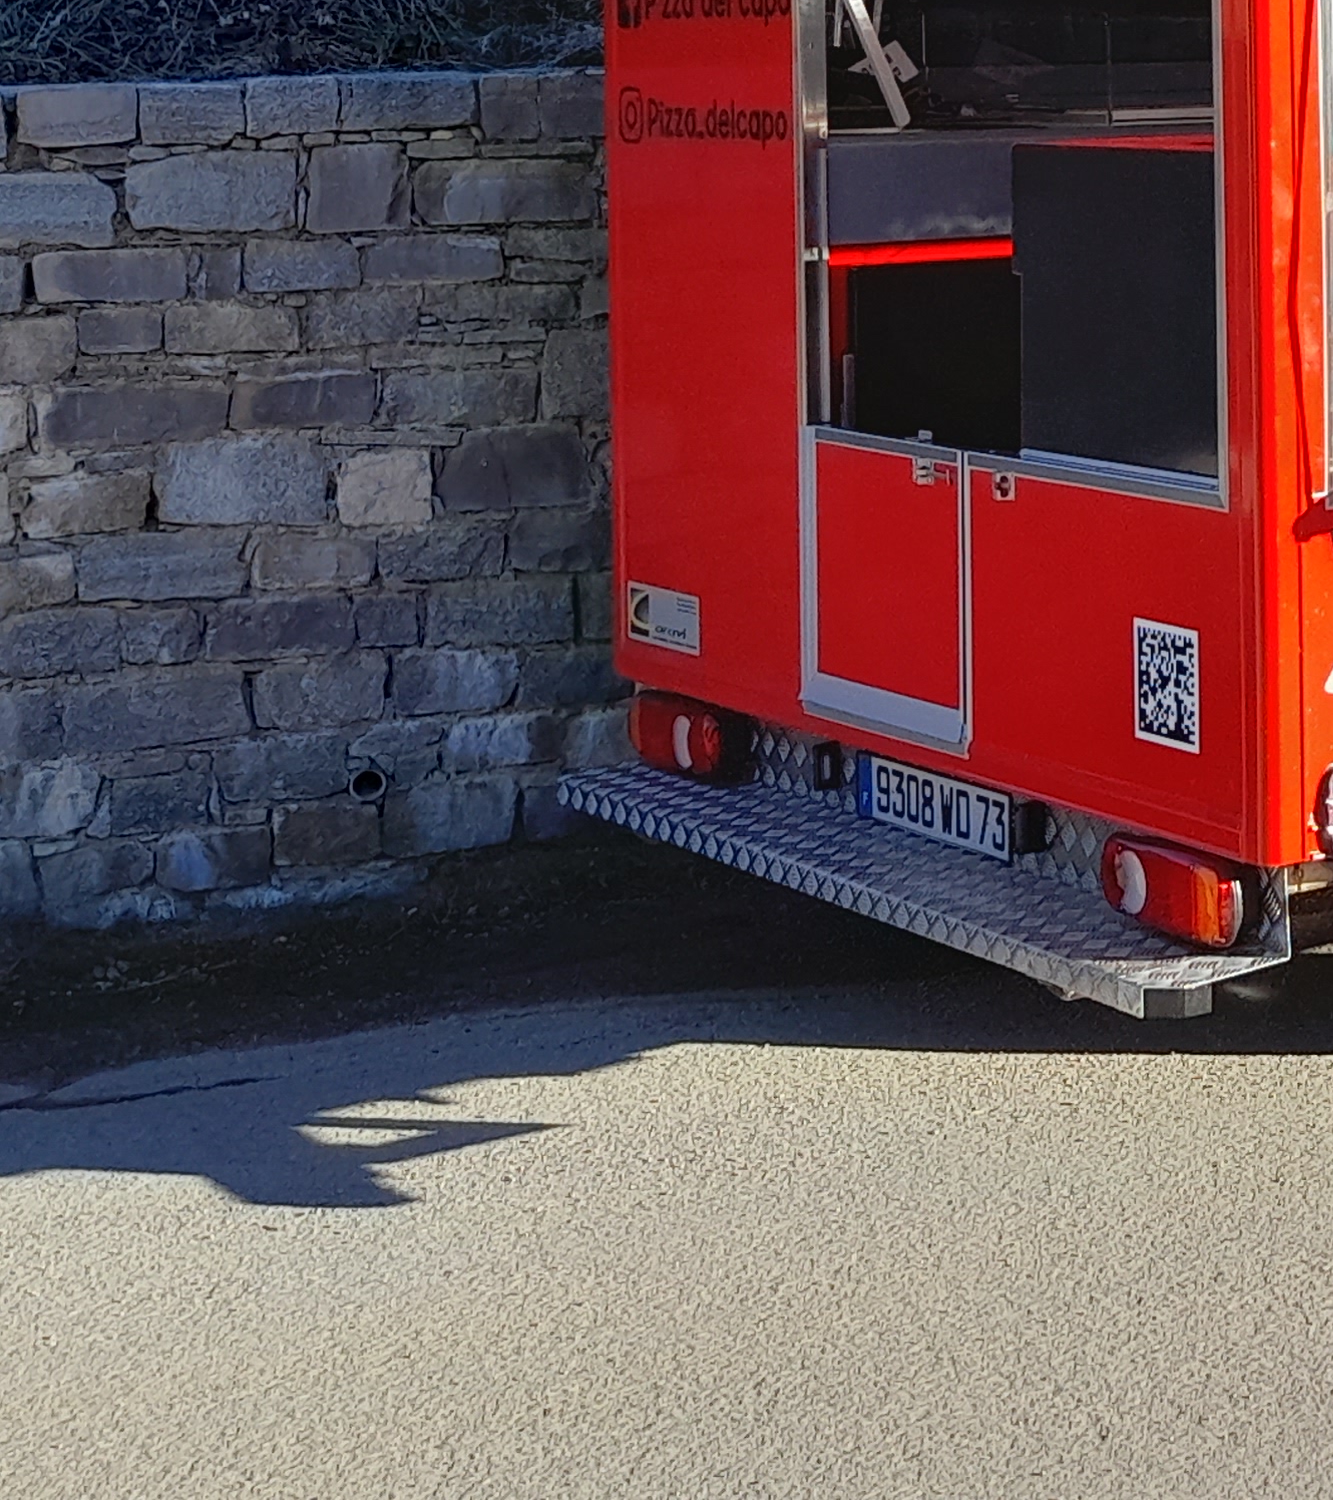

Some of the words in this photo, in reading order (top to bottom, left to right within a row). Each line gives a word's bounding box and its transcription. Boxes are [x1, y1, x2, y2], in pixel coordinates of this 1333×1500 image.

[876, 765, 935, 829] 9308
[939, 783, 971, 840] WD
[975, 794, 1006, 852] 73
